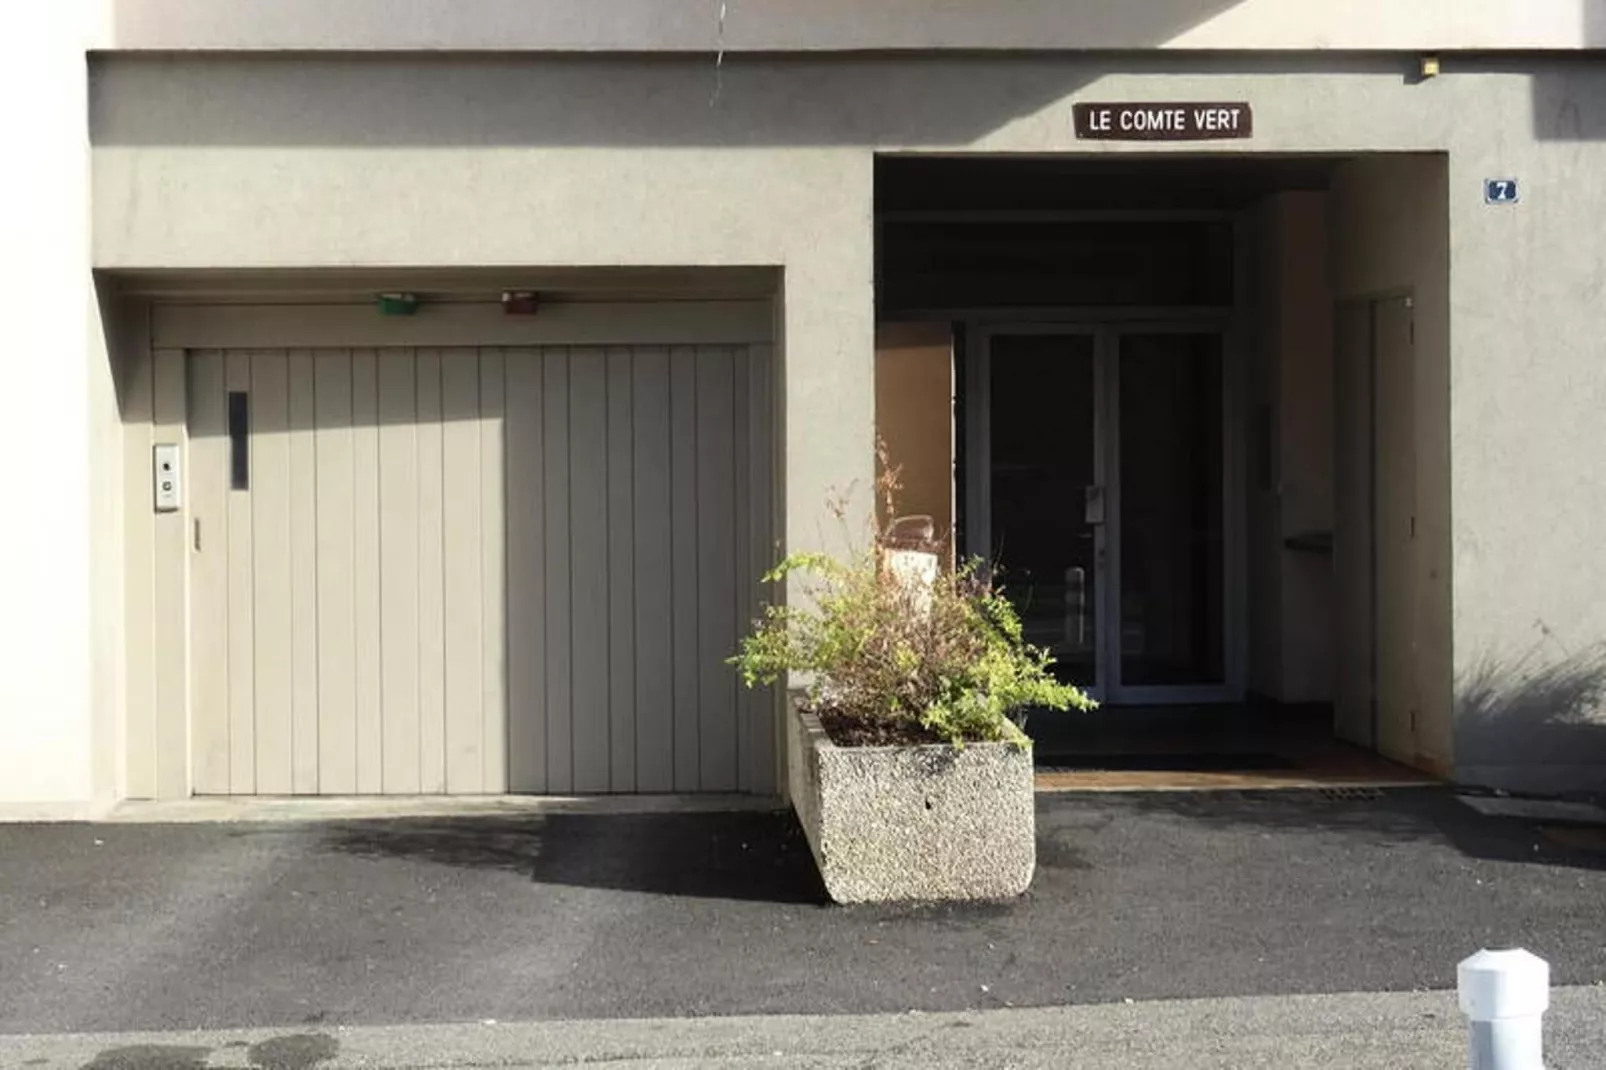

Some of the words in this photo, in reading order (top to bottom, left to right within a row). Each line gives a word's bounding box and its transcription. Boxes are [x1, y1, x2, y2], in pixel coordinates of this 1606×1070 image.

[1089, 109, 1112, 131] LE
[1119, 109, 1186, 131] COMTE
[1193, 108, 1241, 131] VERT
[1496, 182, 1507, 199] 7
